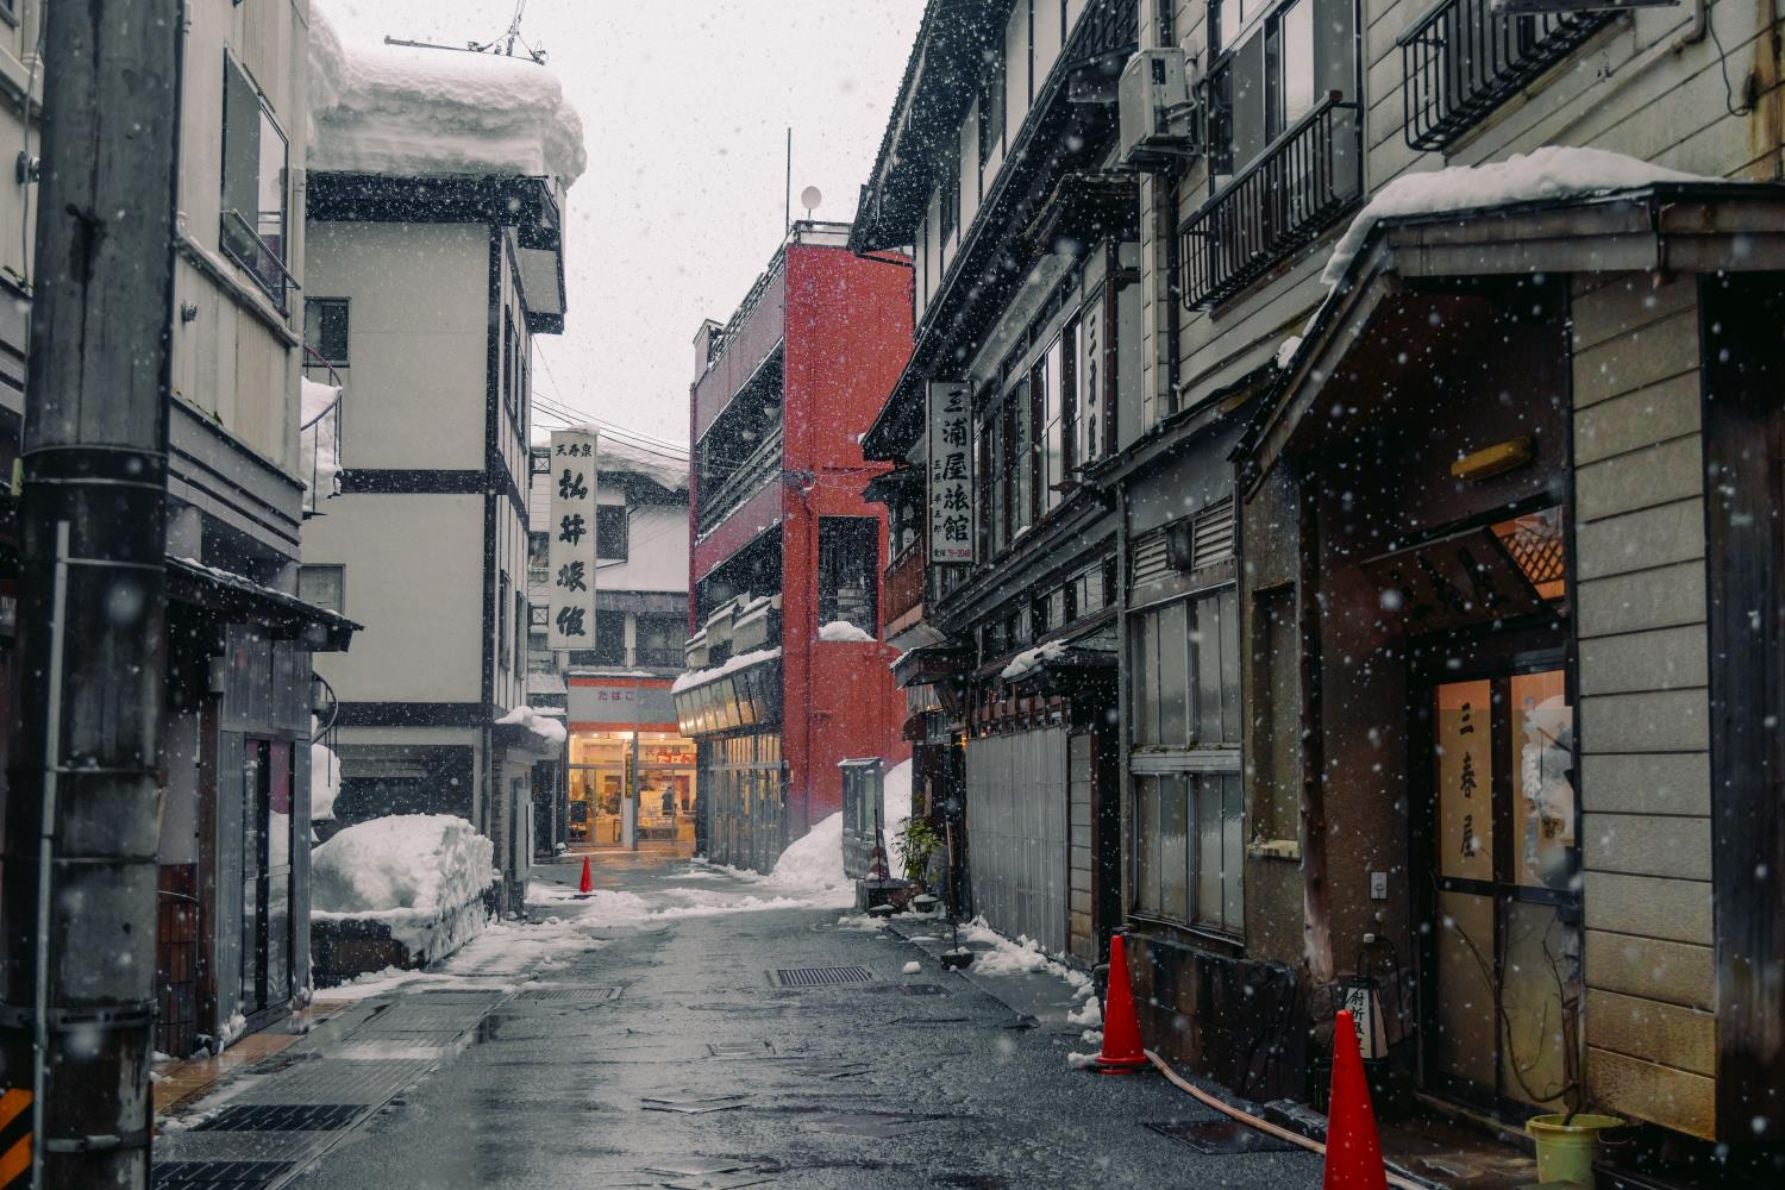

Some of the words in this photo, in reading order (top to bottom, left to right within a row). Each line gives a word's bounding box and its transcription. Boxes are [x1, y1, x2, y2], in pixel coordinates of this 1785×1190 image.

[942, 391, 971, 543] 三浦屋旅館
[598, 690, 635, 701] たばこ
[1459, 702, 1477, 857] 三春屋
